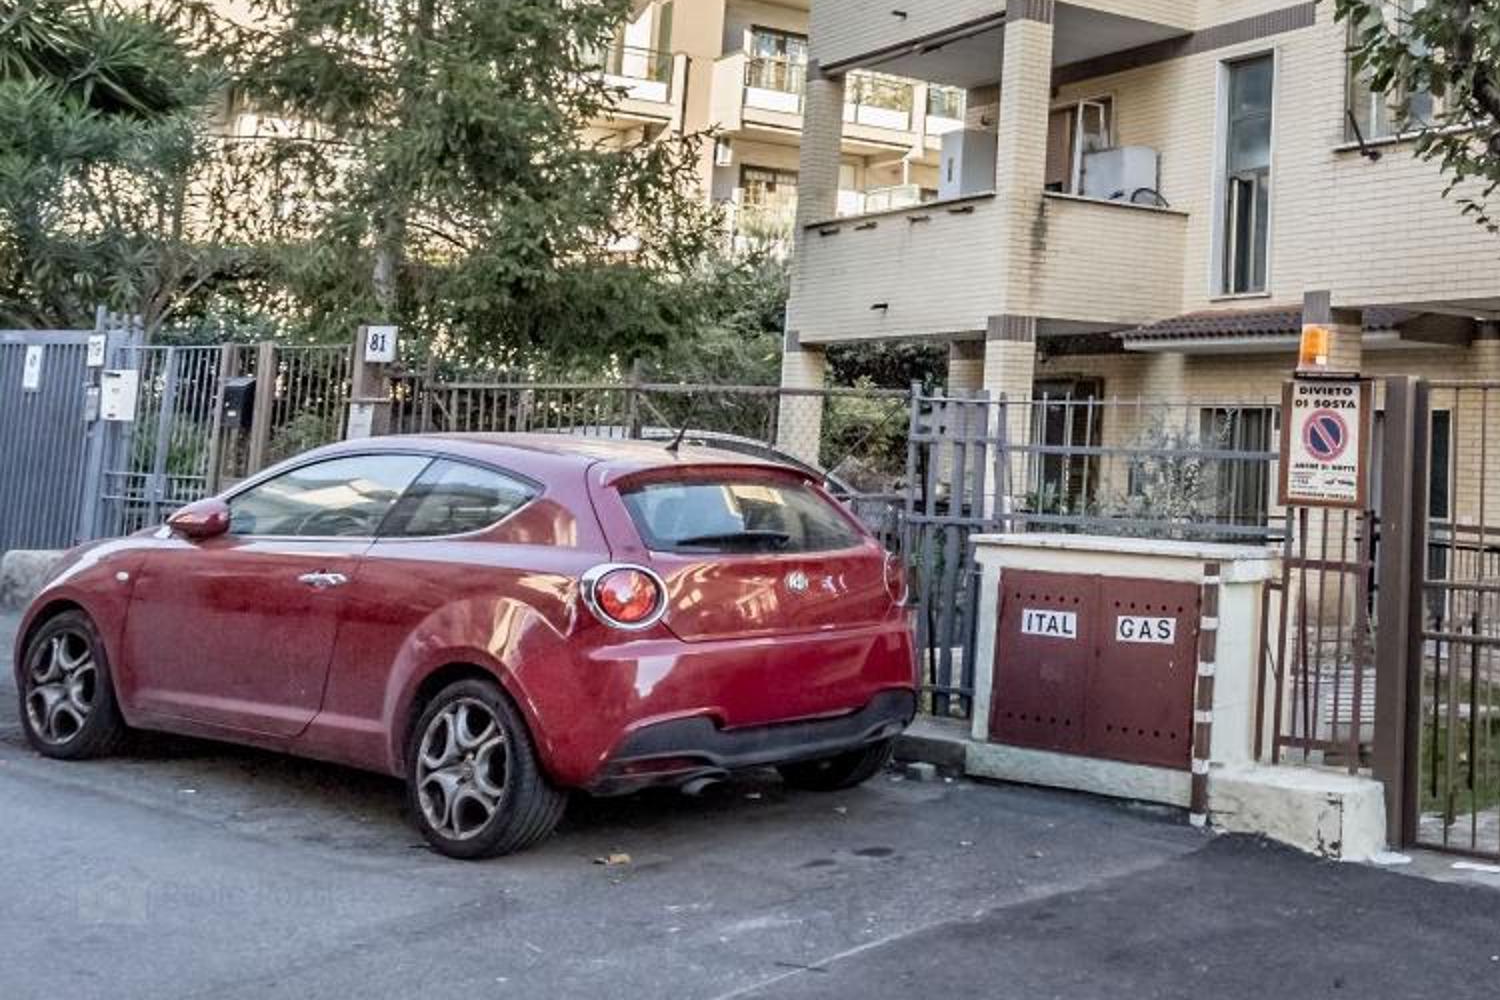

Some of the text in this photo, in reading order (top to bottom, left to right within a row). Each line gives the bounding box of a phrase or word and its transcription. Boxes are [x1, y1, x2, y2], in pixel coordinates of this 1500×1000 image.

[370, 333, 385, 352] 81
[1299, 386, 1353, 396] DIVIETO
[1295, 398, 1356, 409] DI SOSTA
[1027, 612, 1171, 640] ITAL GAS
